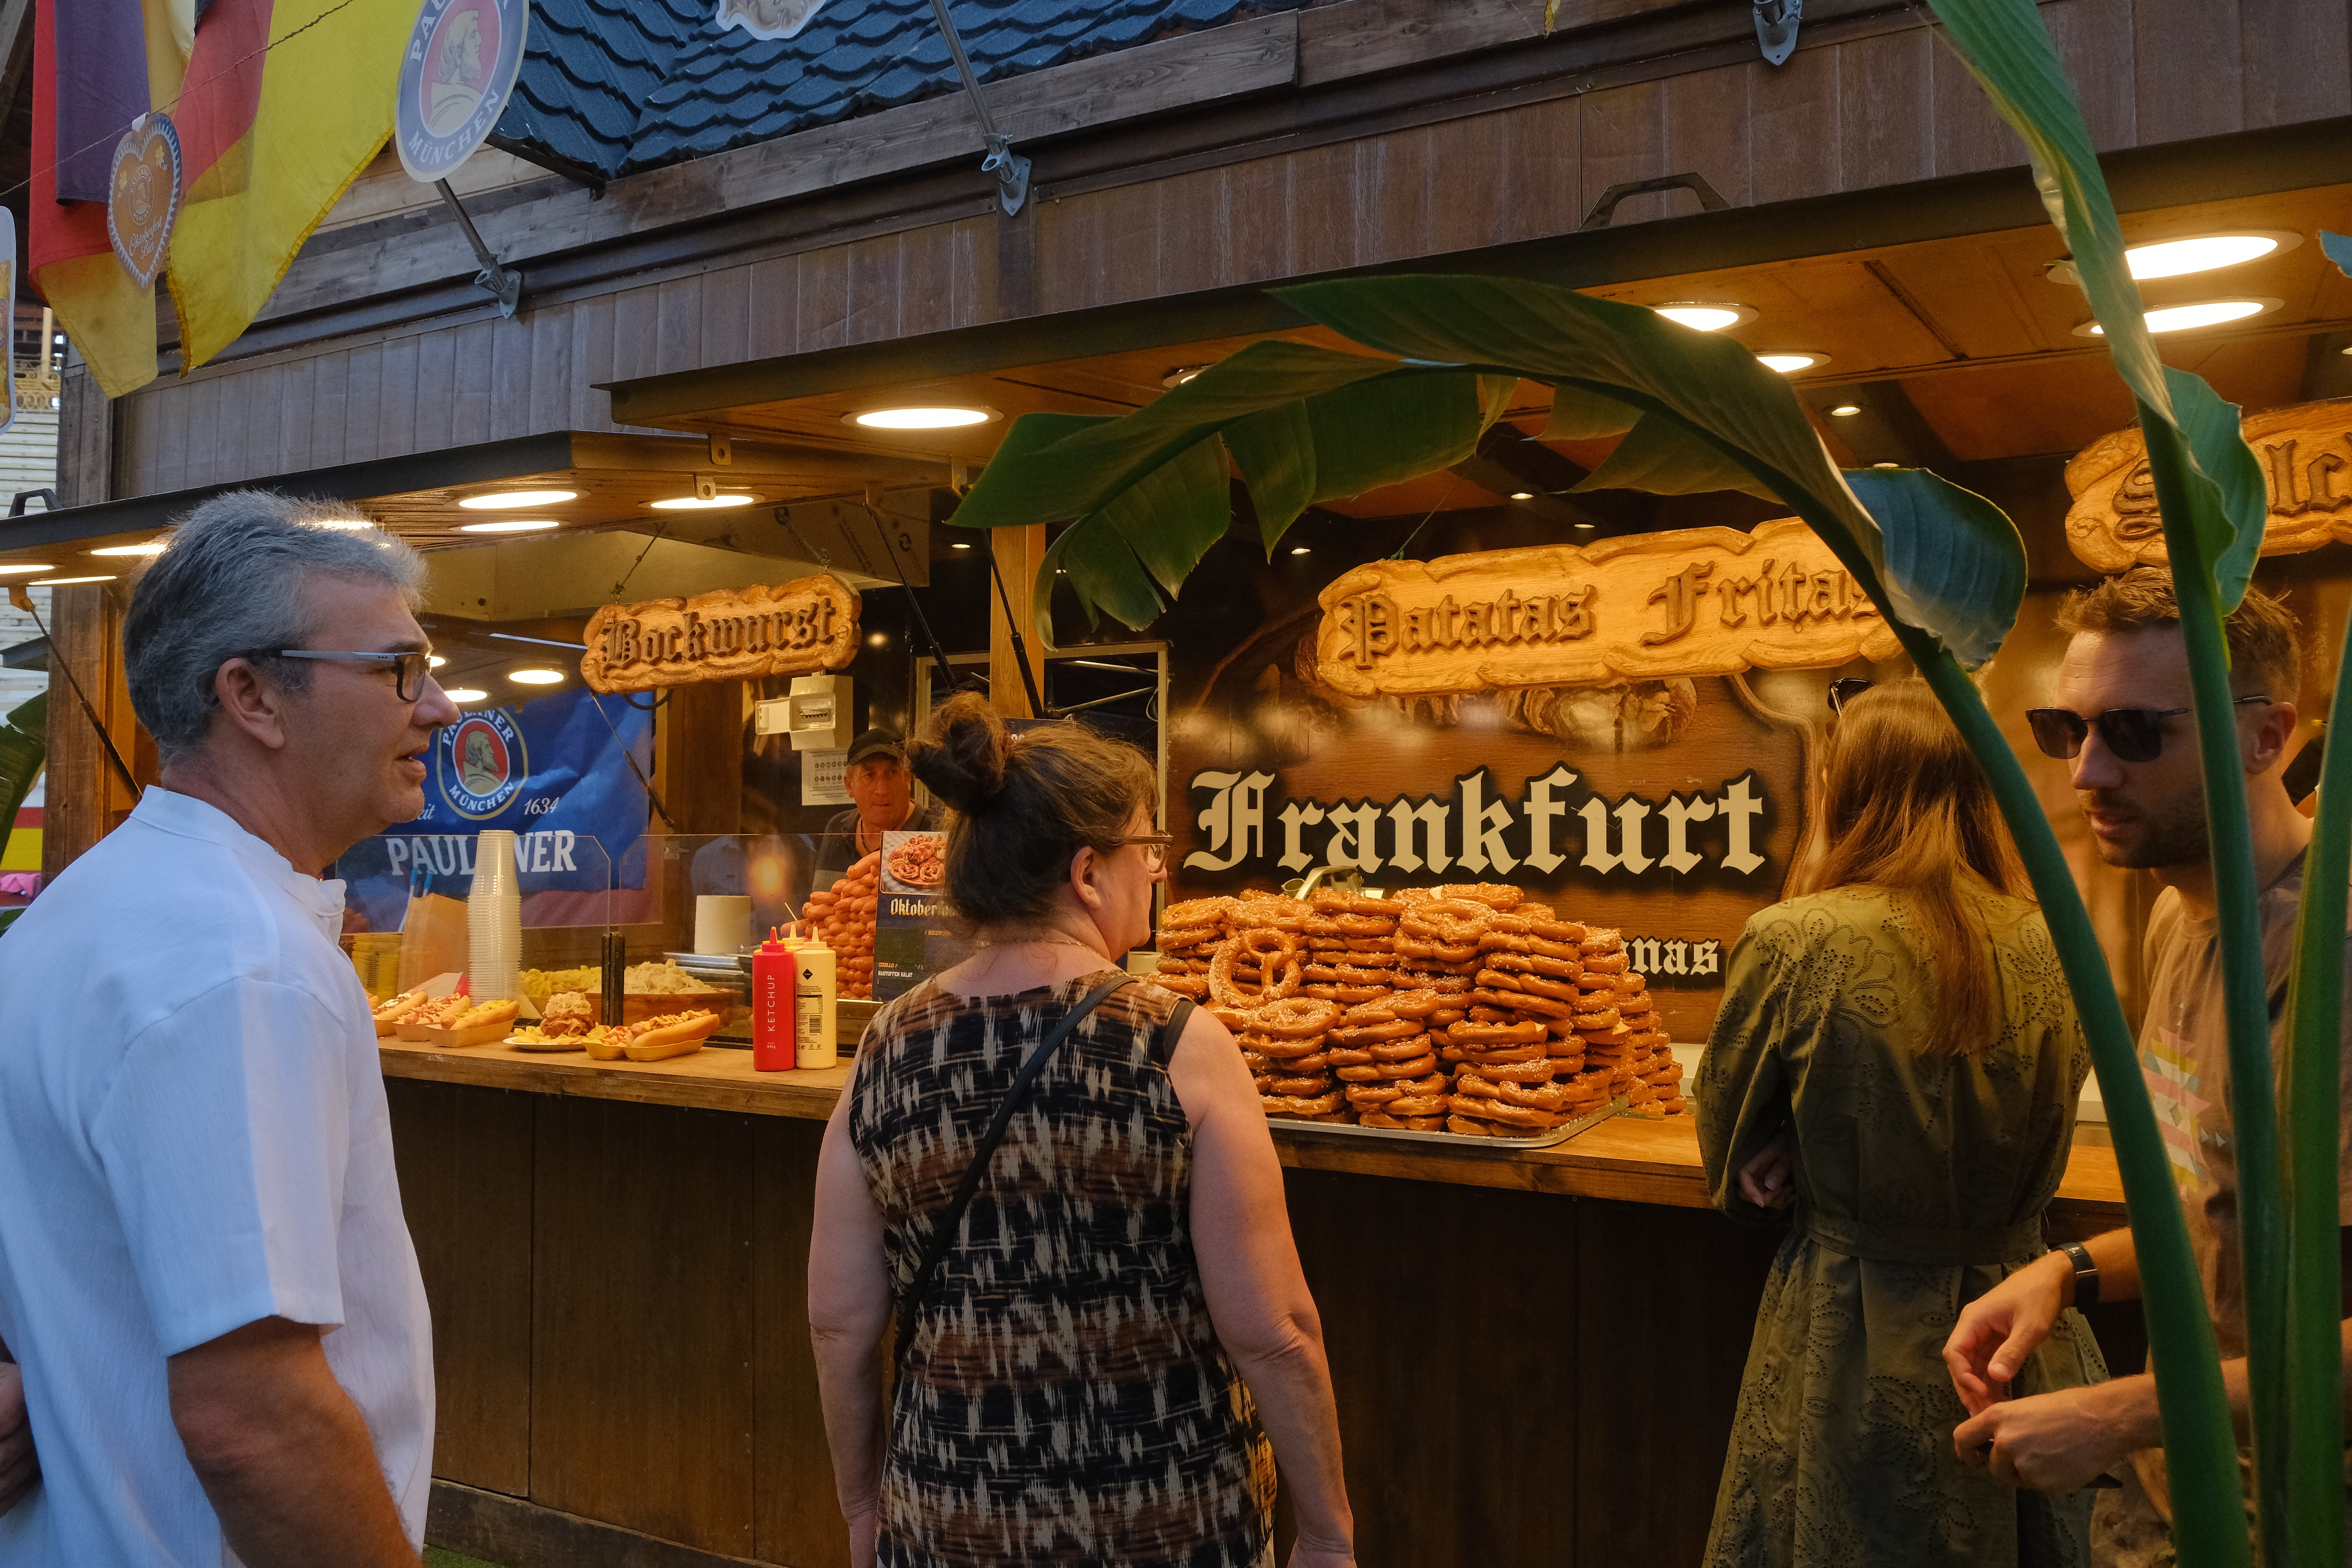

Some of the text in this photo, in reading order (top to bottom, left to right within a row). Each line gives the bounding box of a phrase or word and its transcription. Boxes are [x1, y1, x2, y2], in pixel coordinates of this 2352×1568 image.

[409, 89, 499, 165] MÜNCHEN
[129, 216, 162, 257] Oktoberfest
[141, 239, 155, 260] Bier
[600, 598, 836, 671] Bockwurst
[1337, 584, 1598, 670] Patatas
[449, 781, 515, 811] MÜNCHEN
[524, 796, 560, 815] 1634
[1183, 761, 1766, 875] Frankfurt
[385, 830, 577, 876] PAULNER
